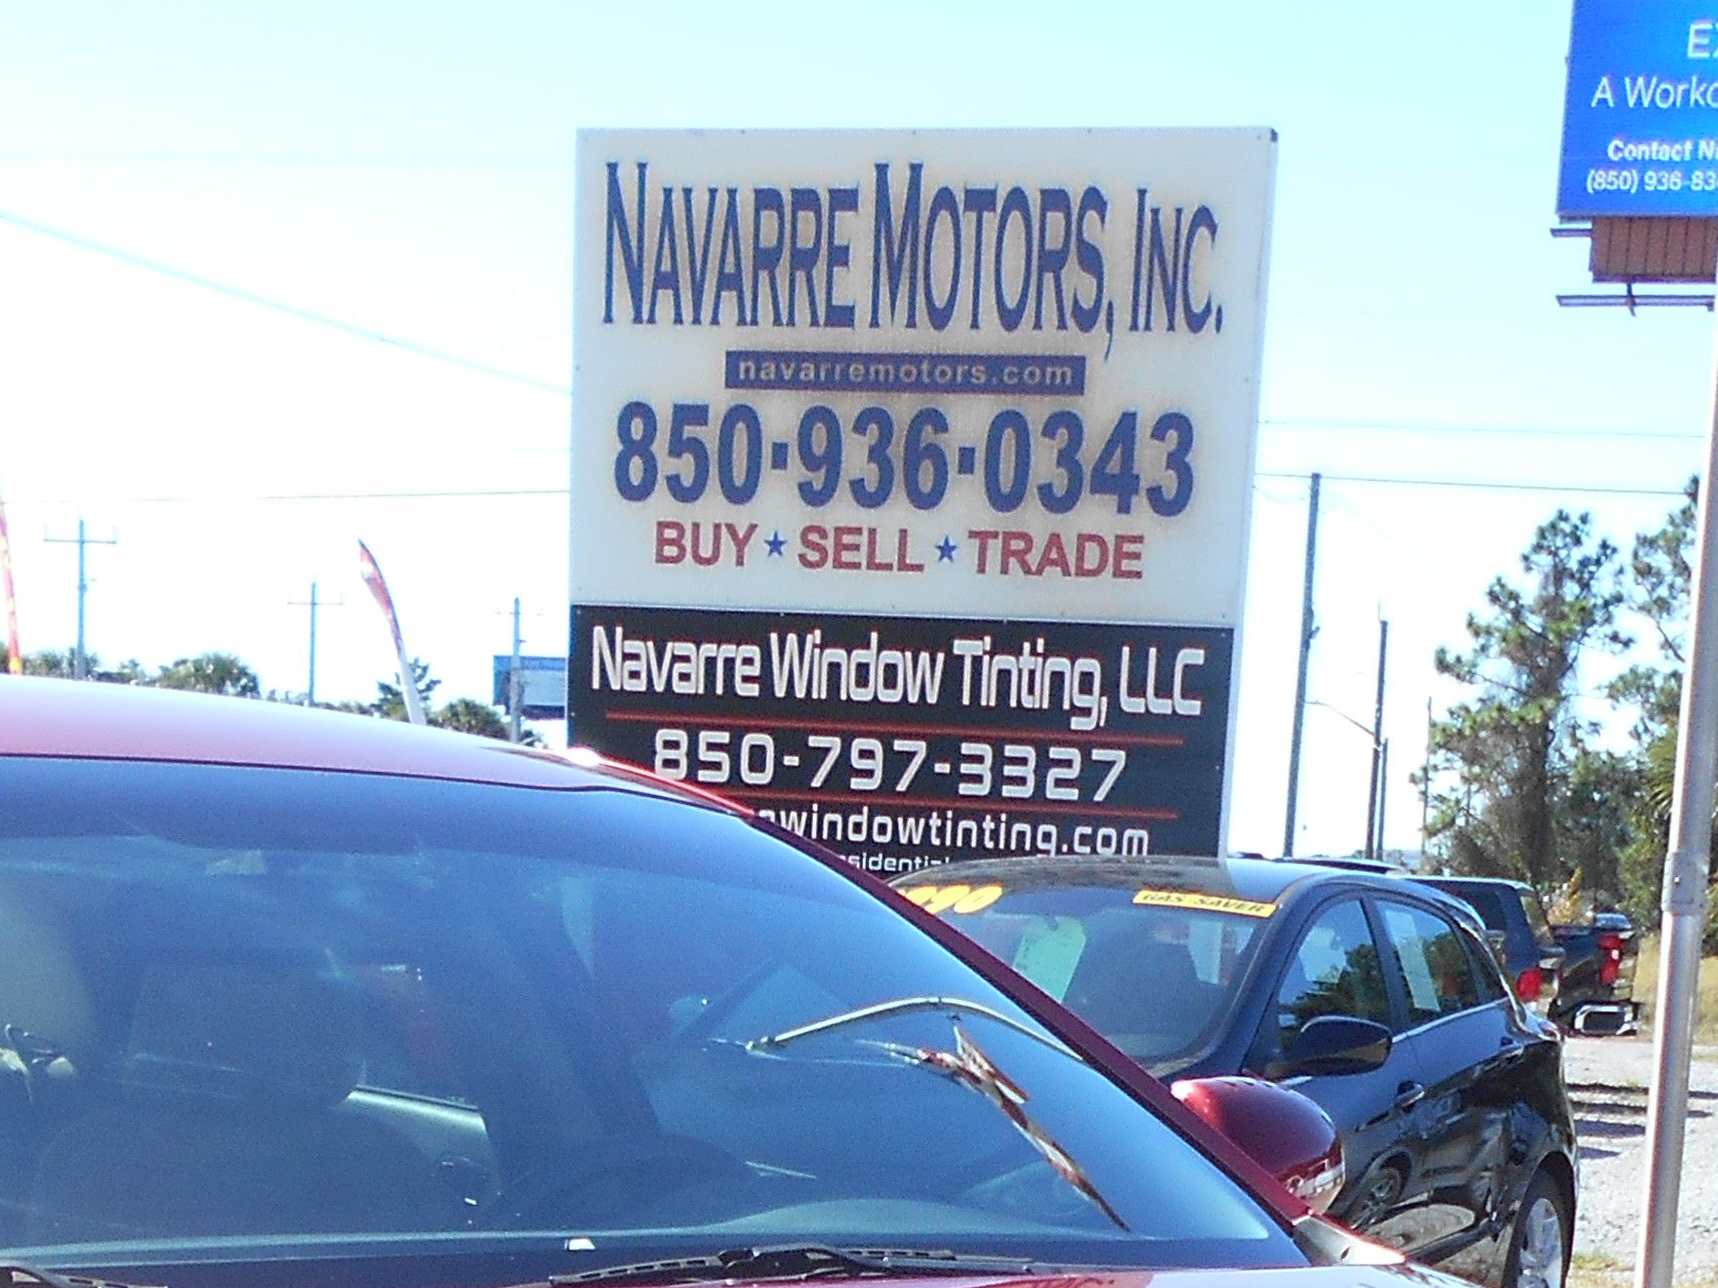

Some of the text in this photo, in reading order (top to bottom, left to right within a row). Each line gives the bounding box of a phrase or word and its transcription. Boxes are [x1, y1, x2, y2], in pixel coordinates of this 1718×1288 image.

[1590, 76, 1615, 108] A
[1607, 139, 1694, 161] Contact
[1586, 169, 1638, 194] (850)
[603, 162, 859, 328] NAVARRE
[737, 358, 1073, 385] navarremotors.com
[654, 520, 1144, 580] BUY SELL TRADE
[591, 625, 761, 697] Navarre
[770, 629, 944, 704] Window
[1119, 645, 1205, 715] LLC
[654, 728, 1126, 802] 850-797-3327
